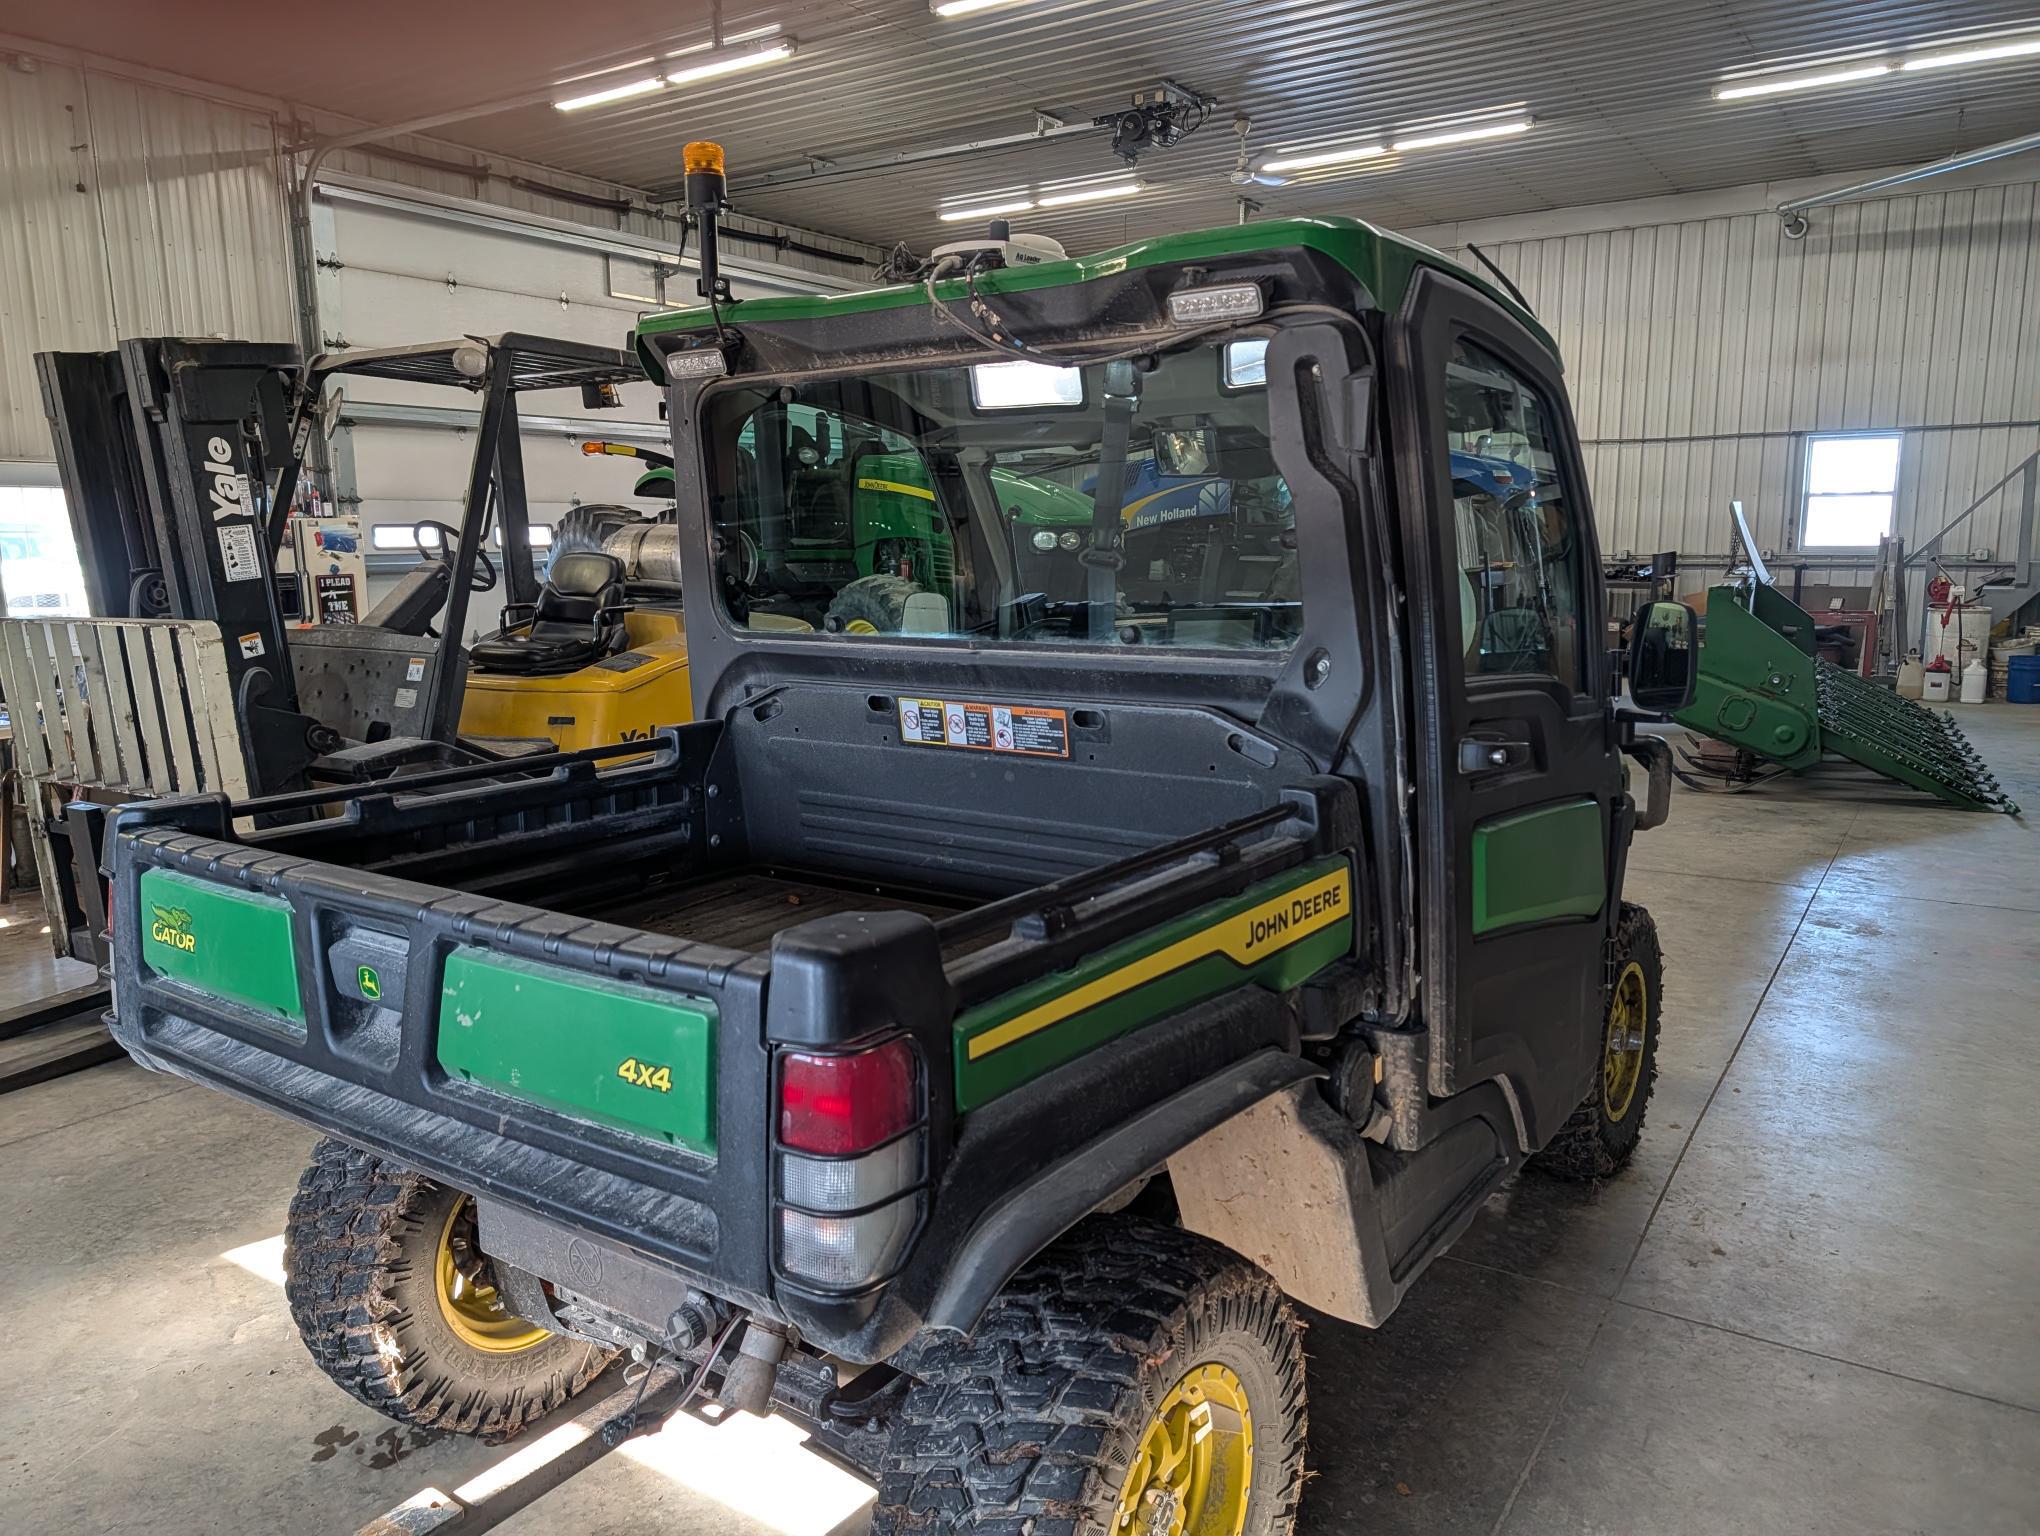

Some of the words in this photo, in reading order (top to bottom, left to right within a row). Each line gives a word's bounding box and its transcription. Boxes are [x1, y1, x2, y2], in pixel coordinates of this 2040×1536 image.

[204, 436, 243, 521] Yale
[1136, 514, 1158, 527] New
[1160, 505, 1197, 522] Holland
[320, 579, 325, 587] I
[325, 577, 351, 587] PLEAD
[328, 600, 348, 611] THE
[620, 724, 656, 742] Yal
[1245, 908, 1289, 949] JOHN
[1291, 885, 1342, 926] DEERE
[152, 922, 195, 953] GATOR
